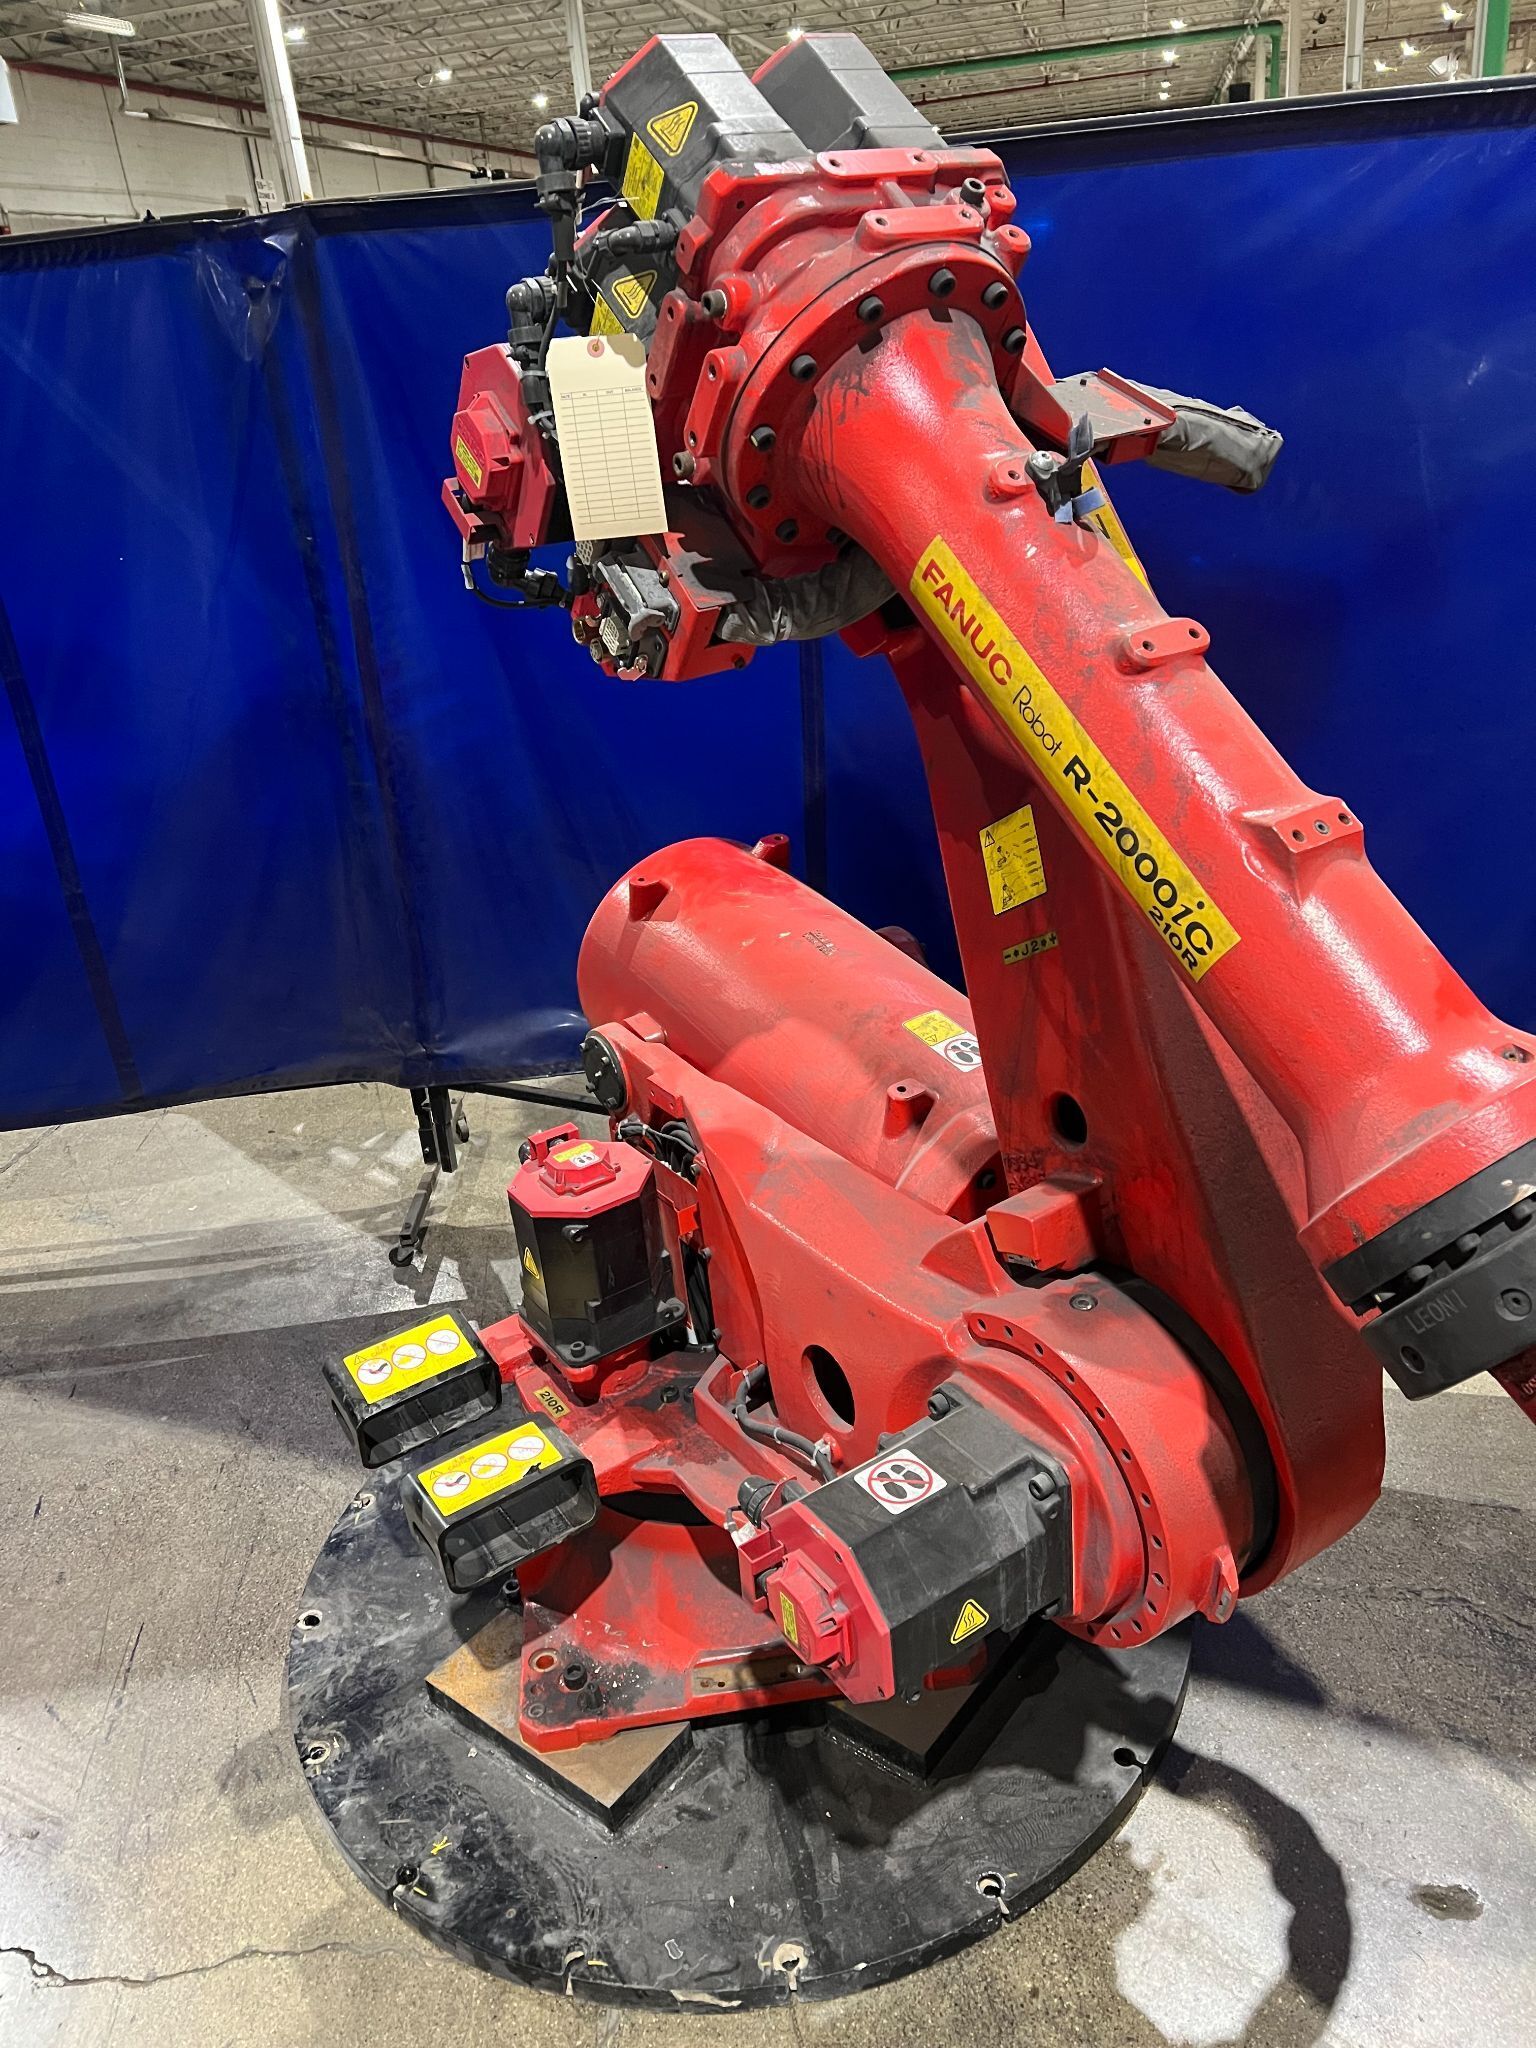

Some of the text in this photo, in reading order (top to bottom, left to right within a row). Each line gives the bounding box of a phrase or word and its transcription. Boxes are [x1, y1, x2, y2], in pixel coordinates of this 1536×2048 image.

[921, 558, 1214, 956] FANUC Robot R-2000iC
[1148, 905, 1198, 971] 210R
[1404, 1288, 1468, 1334] LEONI
[539, 1391, 564, 1414] 210R
